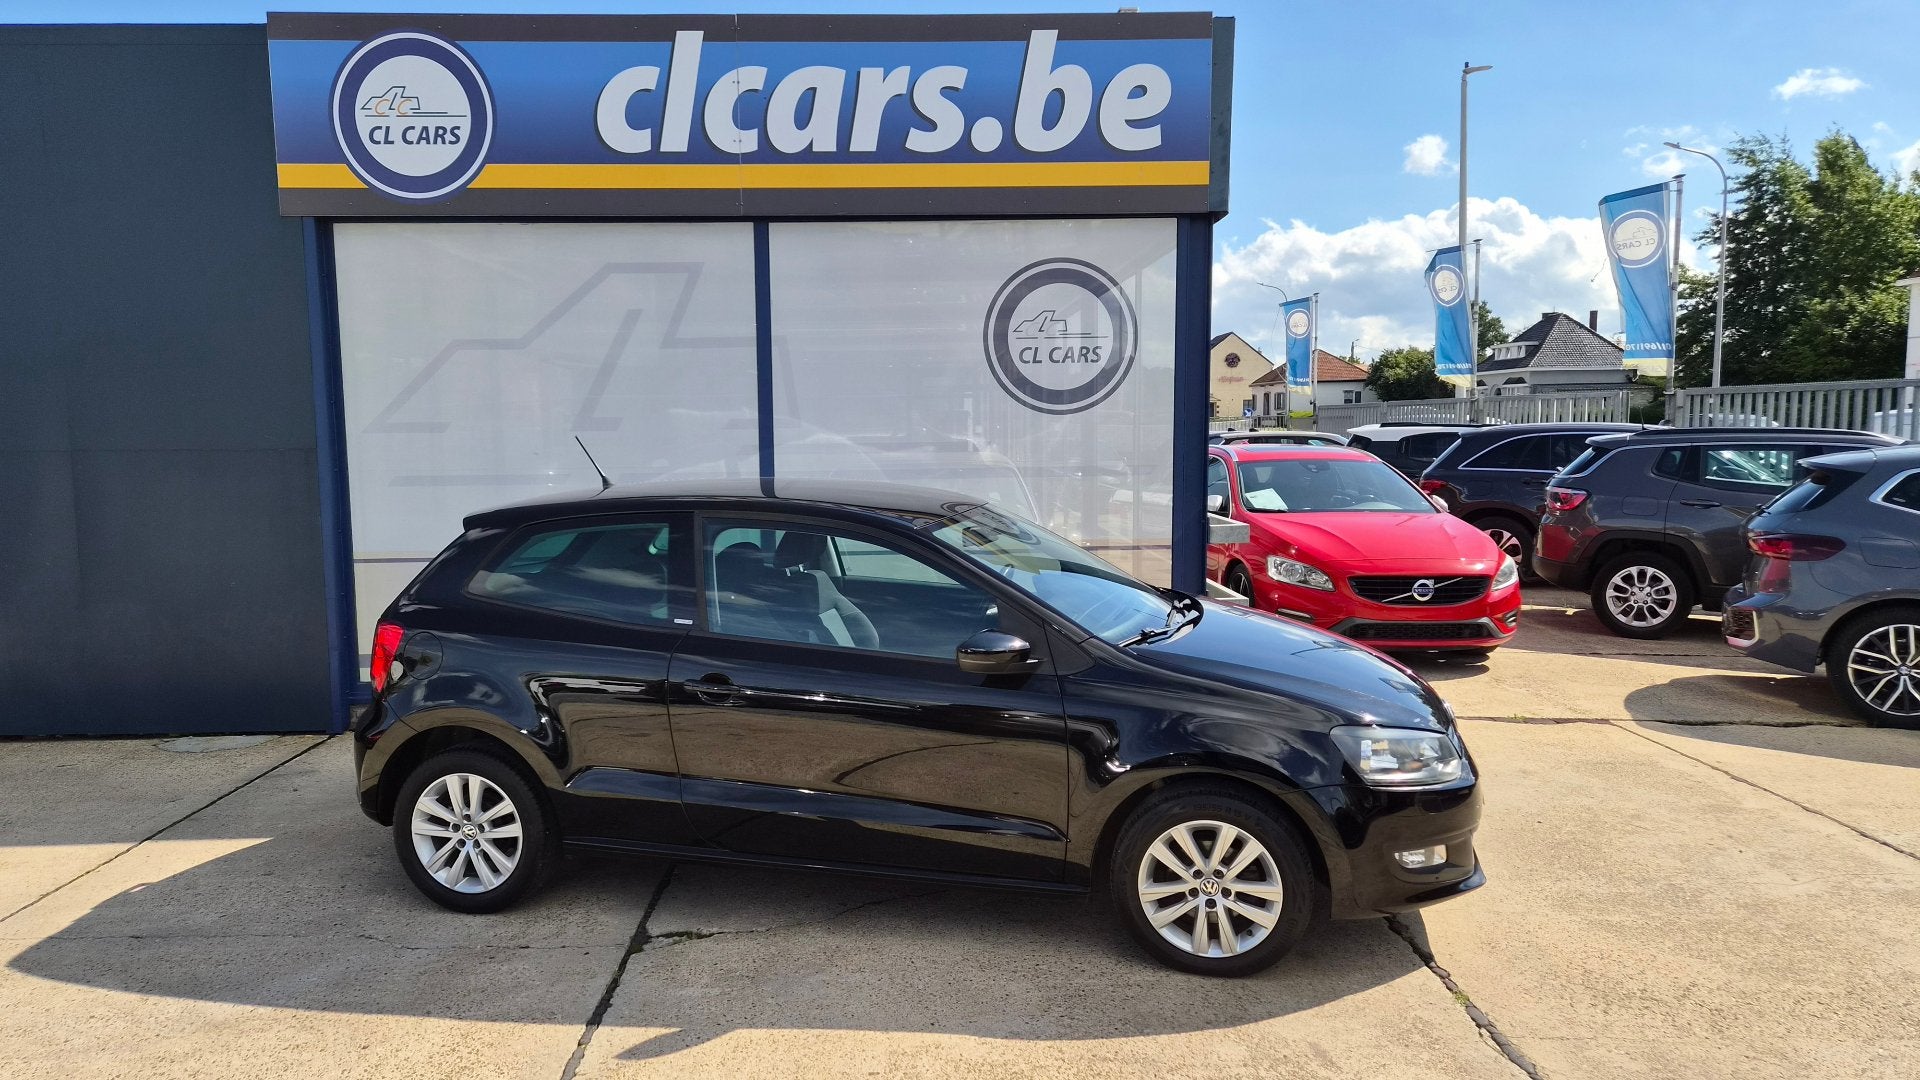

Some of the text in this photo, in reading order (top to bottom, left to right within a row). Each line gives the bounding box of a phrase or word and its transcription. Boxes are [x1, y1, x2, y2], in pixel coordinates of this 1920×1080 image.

[596, 29, 1173, 155] clcars.be
[368, 125, 462, 145] CL CARS
[1018, 345, 1103, 365] CL CARS
